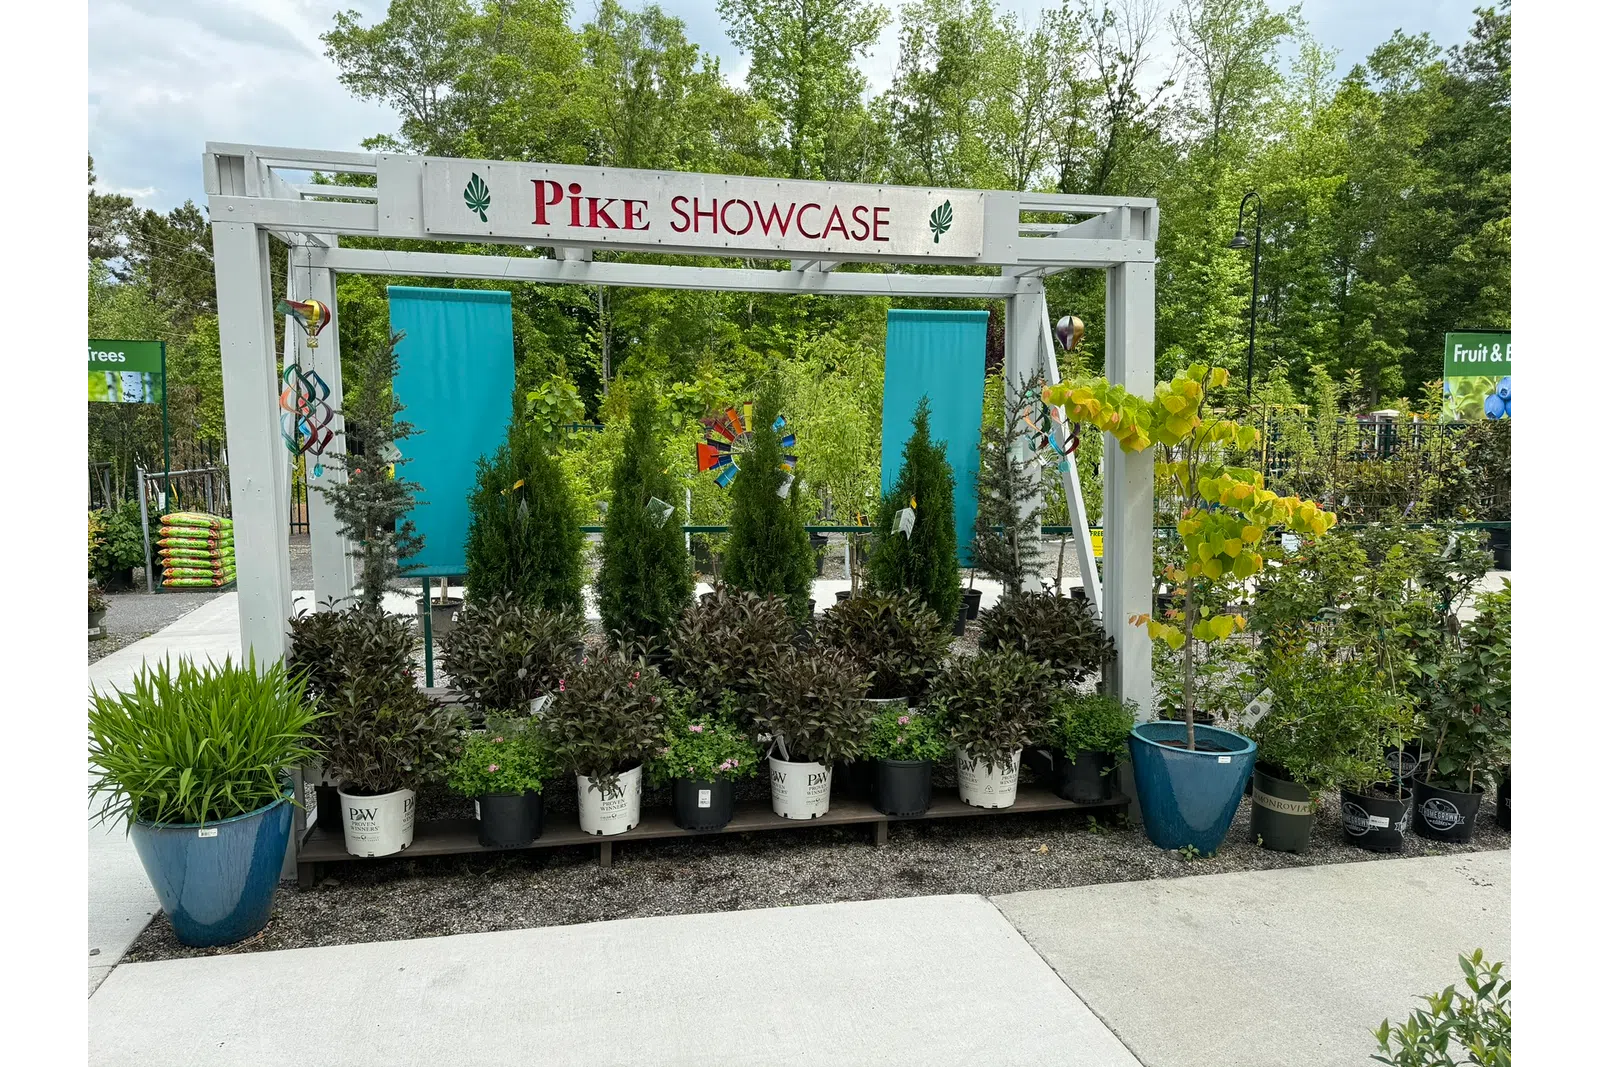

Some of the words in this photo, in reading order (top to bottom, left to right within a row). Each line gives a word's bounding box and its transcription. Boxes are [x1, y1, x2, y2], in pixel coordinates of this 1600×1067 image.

[670, 195, 891, 242] SHOWCASE
[1453, 343, 1488, 363] Fruit
[1490, 343, 1503, 363] &
[600, 802, 628, 811] WINNERS
[602, 799, 625, 807] PROVEN
[348, 807, 378, 821] PW
